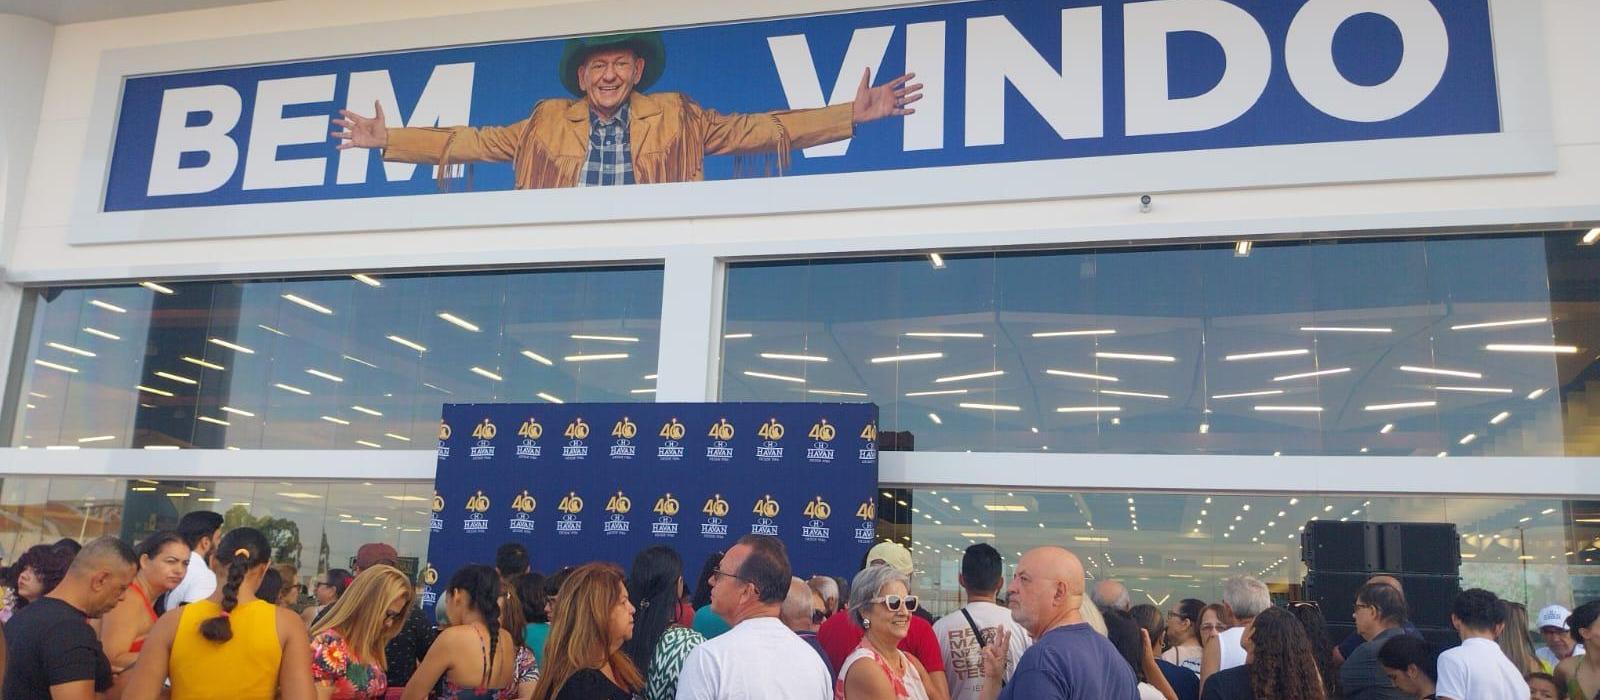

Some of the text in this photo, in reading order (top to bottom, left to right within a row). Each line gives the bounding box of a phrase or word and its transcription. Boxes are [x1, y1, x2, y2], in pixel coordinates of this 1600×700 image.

[146, 0, 1449, 197] BEM VINDO
[472, 424, 497, 440] 40
[518, 422, 542, 439] 40
[564, 423, 589, 439] 40
[612, 421, 637, 438] 40
[659, 423, 685, 440] 40
[708, 424, 734, 440] 40
[758, 423, 784, 440] 40
[808, 424, 836, 441] 40
[470, 447, 495, 456] HAVAN
[517, 446, 541, 456] HAVAN
[563, 446, 588, 456] HAVAN
[610, 446, 635, 455] HAVAN
[658, 447, 683, 456] HAVAN
[707, 447, 733, 457] HAVAN
[757, 447, 783, 457] HAVAN
[807, 449, 834, 459] HAVAN
[465, 496, 490, 513] 40
[511, 495, 536, 513] 40
[558, 496, 583, 513] 40
[605, 496, 631, 513] 40
[653, 498, 679, 516] 40
[702, 499, 729, 516] 40
[753, 500, 779, 517] 40
[803, 501, 831, 519] 40
[464, 520, 488, 529] HAVAN
[510, 519, 534, 529] HAVAN
[557, 521, 581, 530] HAVAN
[604, 521, 629, 531] HAVAN
[652, 523, 678, 533] HAVAN
[701, 524, 728, 534] HAVAN
[751, 524, 778, 535] HAVAN
[802, 527, 829, 538] HAVAN
